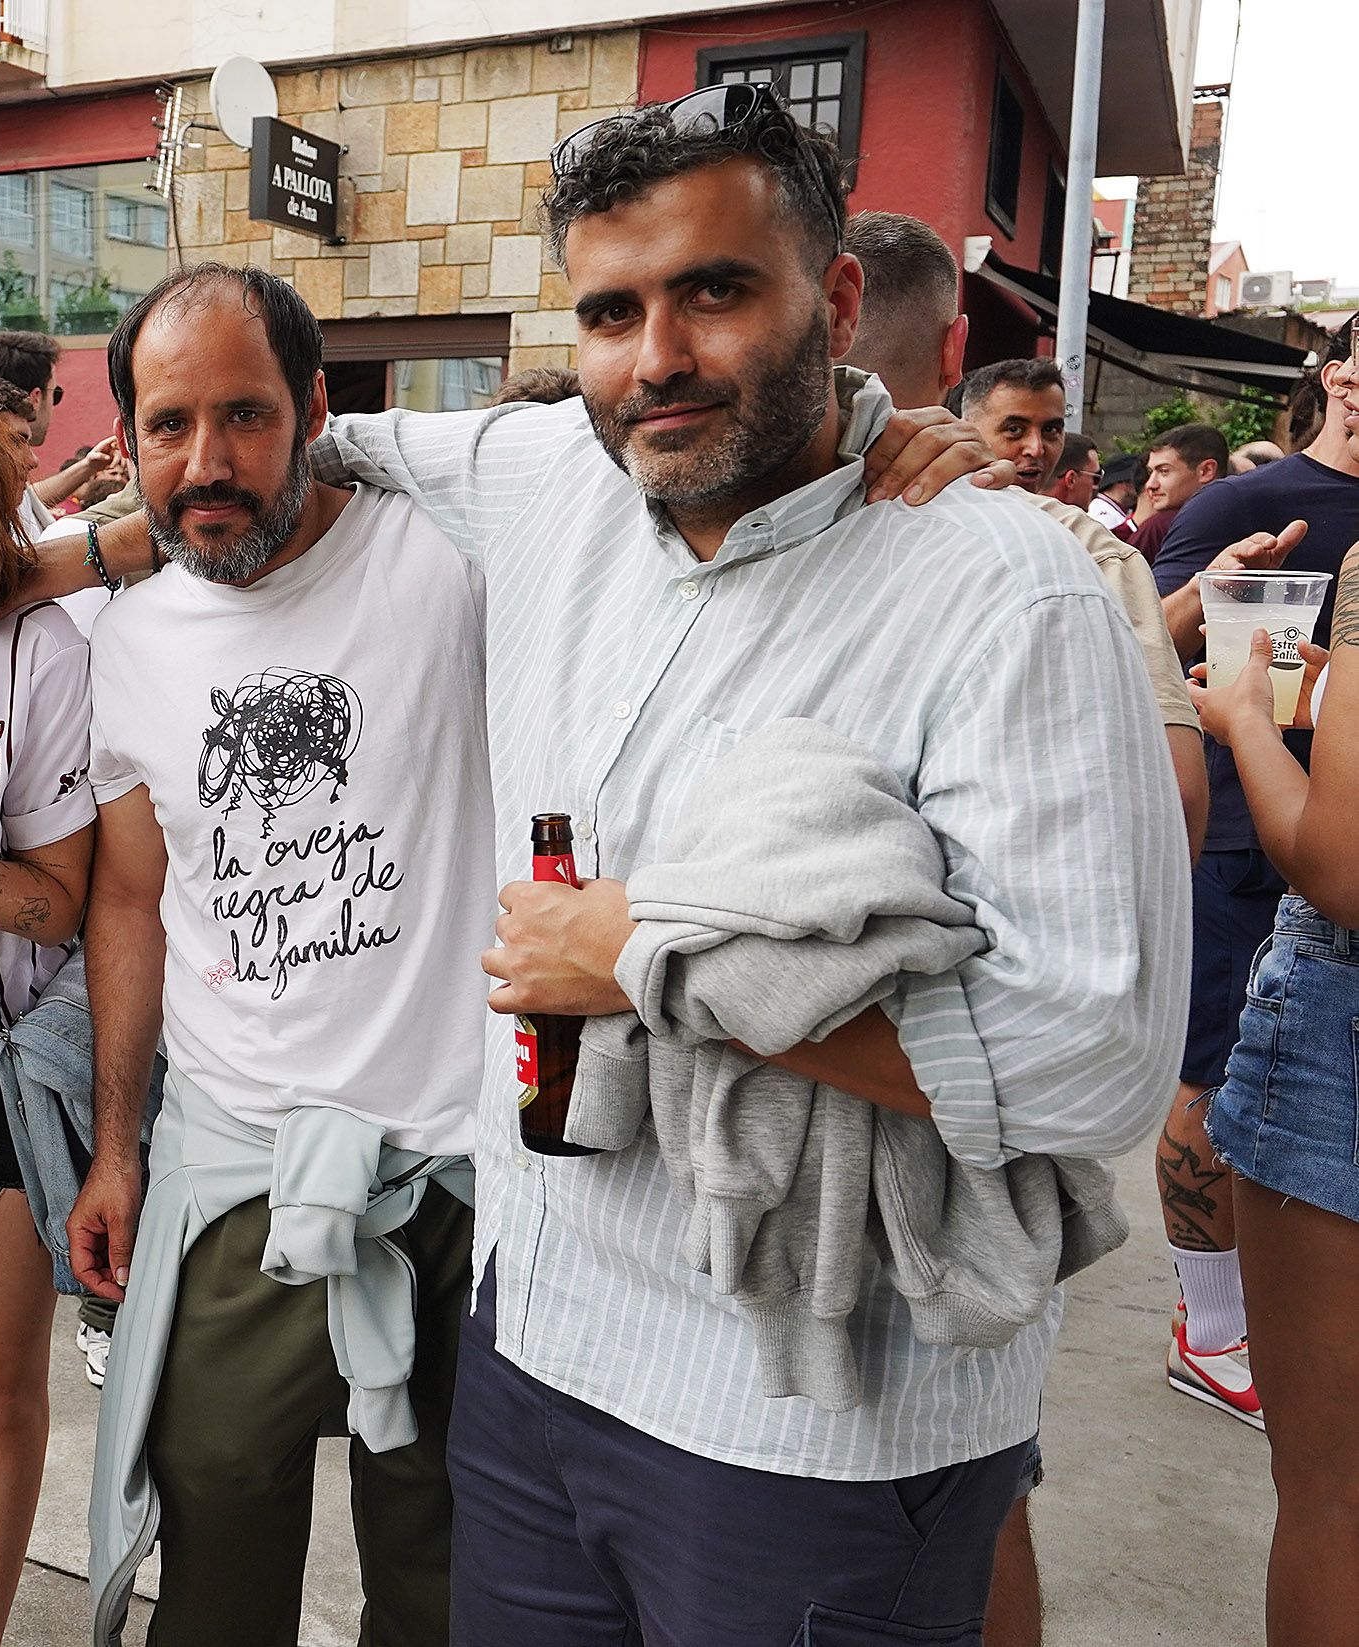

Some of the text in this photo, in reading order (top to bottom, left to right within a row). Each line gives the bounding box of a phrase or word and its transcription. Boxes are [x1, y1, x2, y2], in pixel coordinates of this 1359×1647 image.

[272, 163, 333, 204] A PALLOTA
[287, 195, 300, 217] de
[1272, 639, 1297, 650] Estre
[213, 820, 384, 881] la oveja
[212, 846, 405, 948] negra de
[230, 930, 270, 982] la
[269, 898, 401, 1000] familia
